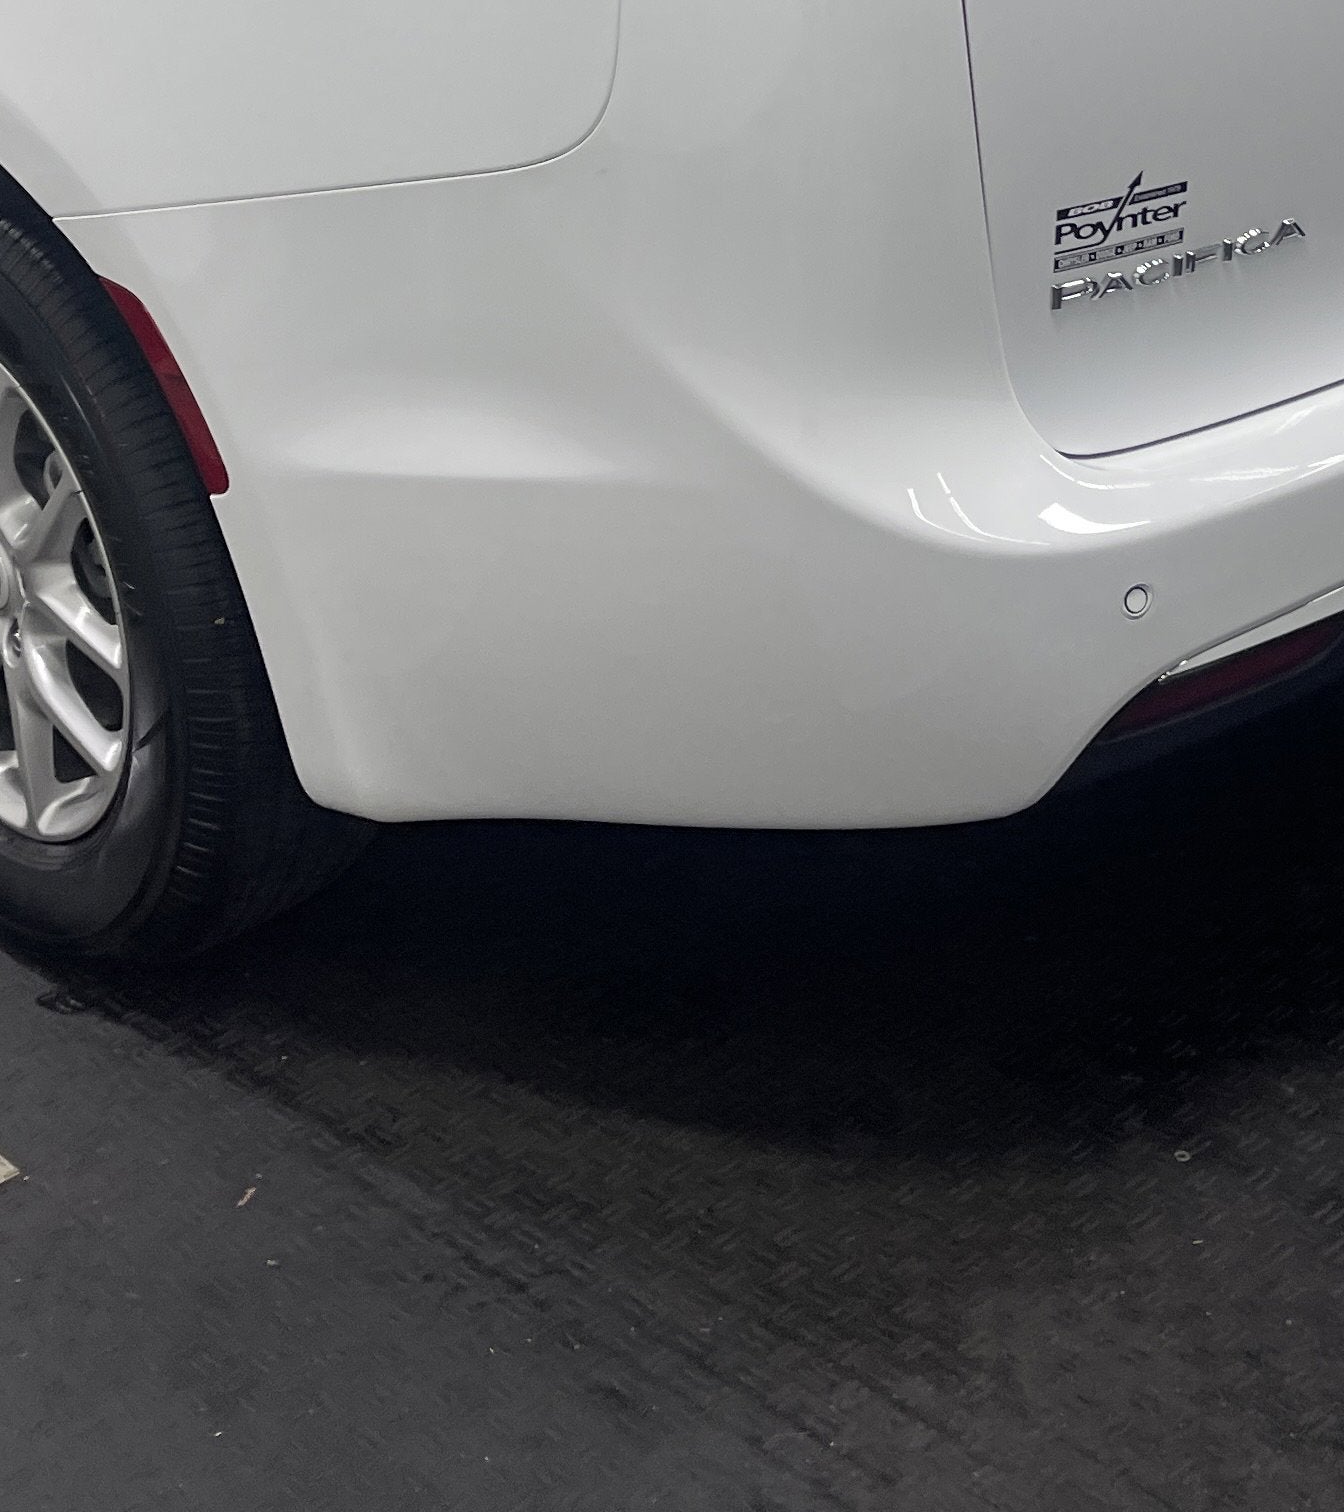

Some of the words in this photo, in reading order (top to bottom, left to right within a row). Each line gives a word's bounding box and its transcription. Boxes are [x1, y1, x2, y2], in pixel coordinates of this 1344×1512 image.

[1054, 201, 1187, 255] Poynter
[1067, 199, 1114, 217] BOB
[1051, 217, 1306, 311] PACIFICA
